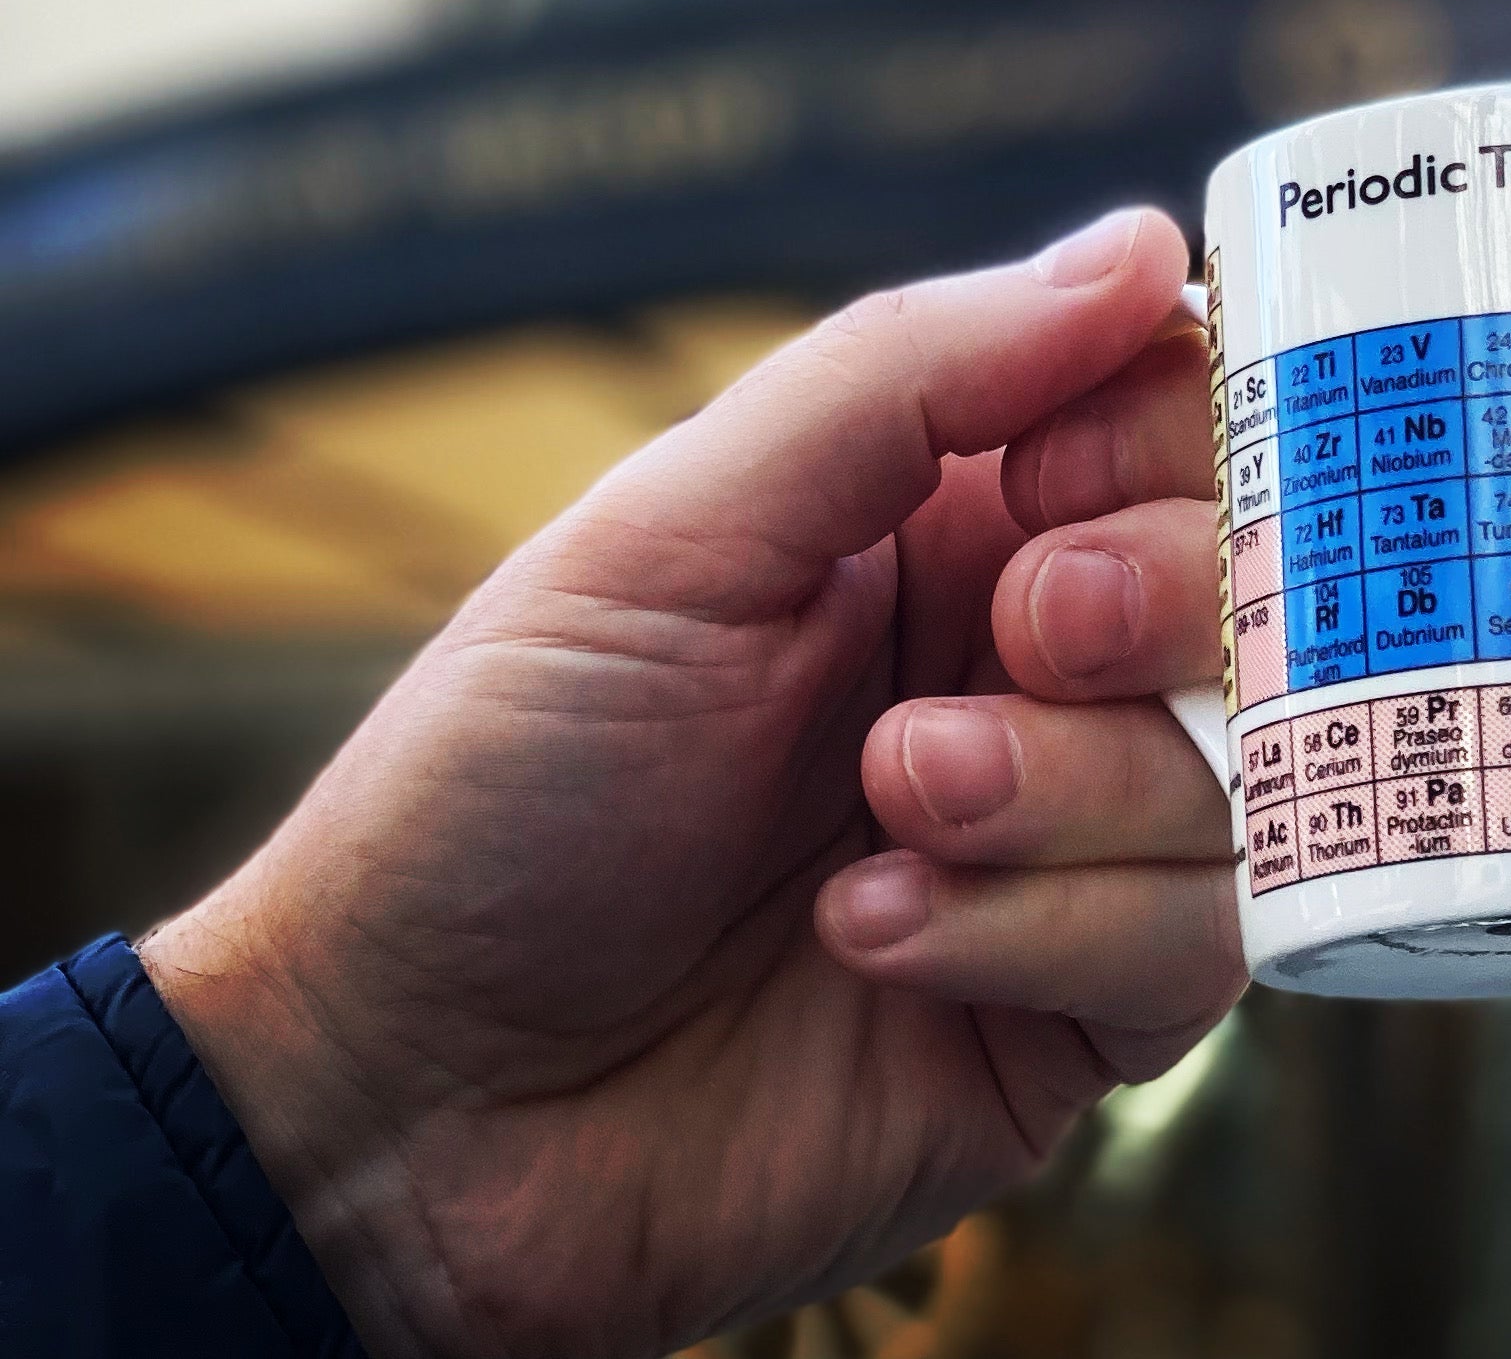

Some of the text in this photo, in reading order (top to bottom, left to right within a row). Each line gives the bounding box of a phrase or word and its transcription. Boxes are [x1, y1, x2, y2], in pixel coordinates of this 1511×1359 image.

[1280, 154, 1467, 228] Periodic
[1380, 332, 1431, 365] 23 V
[1486, 331, 1511, 352] 24
[1291, 350, 1336, 387] 22 Ti
[1361, 367, 1456, 396] Vanadium
[1233, 376, 1266, 410] 21 Sc
[1284, 385, 1349, 415] Titanium
[1228, 406, 1276, 439] Scandium
[1374, 412, 1446, 446] 41 Nb
[1481, 406, 1508, 426] 42
[1293, 431, 1342, 464] 40 Zr
[1372, 448, 1451, 476] Niobium
[1239, 452, 1263, 486] 39 Y
[1283, 463, 1358, 496] Zirconium
[1237, 488, 1270, 513] Yttrium
[1380, 493, 1445, 526] 73 Ta
[1295, 507, 1343, 545] 72 Hf
[1370, 527, 1459, 556] Tantalum
[1290, 544, 1353, 573] Hafnium
[1400, 566, 1432, 587] 105
[1316, 581, 1339, 603] 104
[1397, 588, 1437, 618] Db
[1316, 602, 1339, 633] Rf
[1289, 634, 1367, 667] Rutherford
[1376, 623, 1464, 651] Dubnium
[1396, 695, 1460, 727] 59 Pr
[1303, 721, 1360, 754] 58 Ce
[1393, 726, 1463, 749] Praseo
[1261, 740, 1282, 768] La
[1390, 745, 1469, 774] dymium
[1305, 757, 1362, 782] Cerium
[1396, 778, 1464, 810] 91 Pa
[1309, 800, 1363, 835] 90 Th
[1387, 810, 1473, 836] Protactin
[1266, 819, 1288, 848] Ac
[1408, 835, 1451, 854] -ium
[1307, 837, 1371, 863] Thorium
